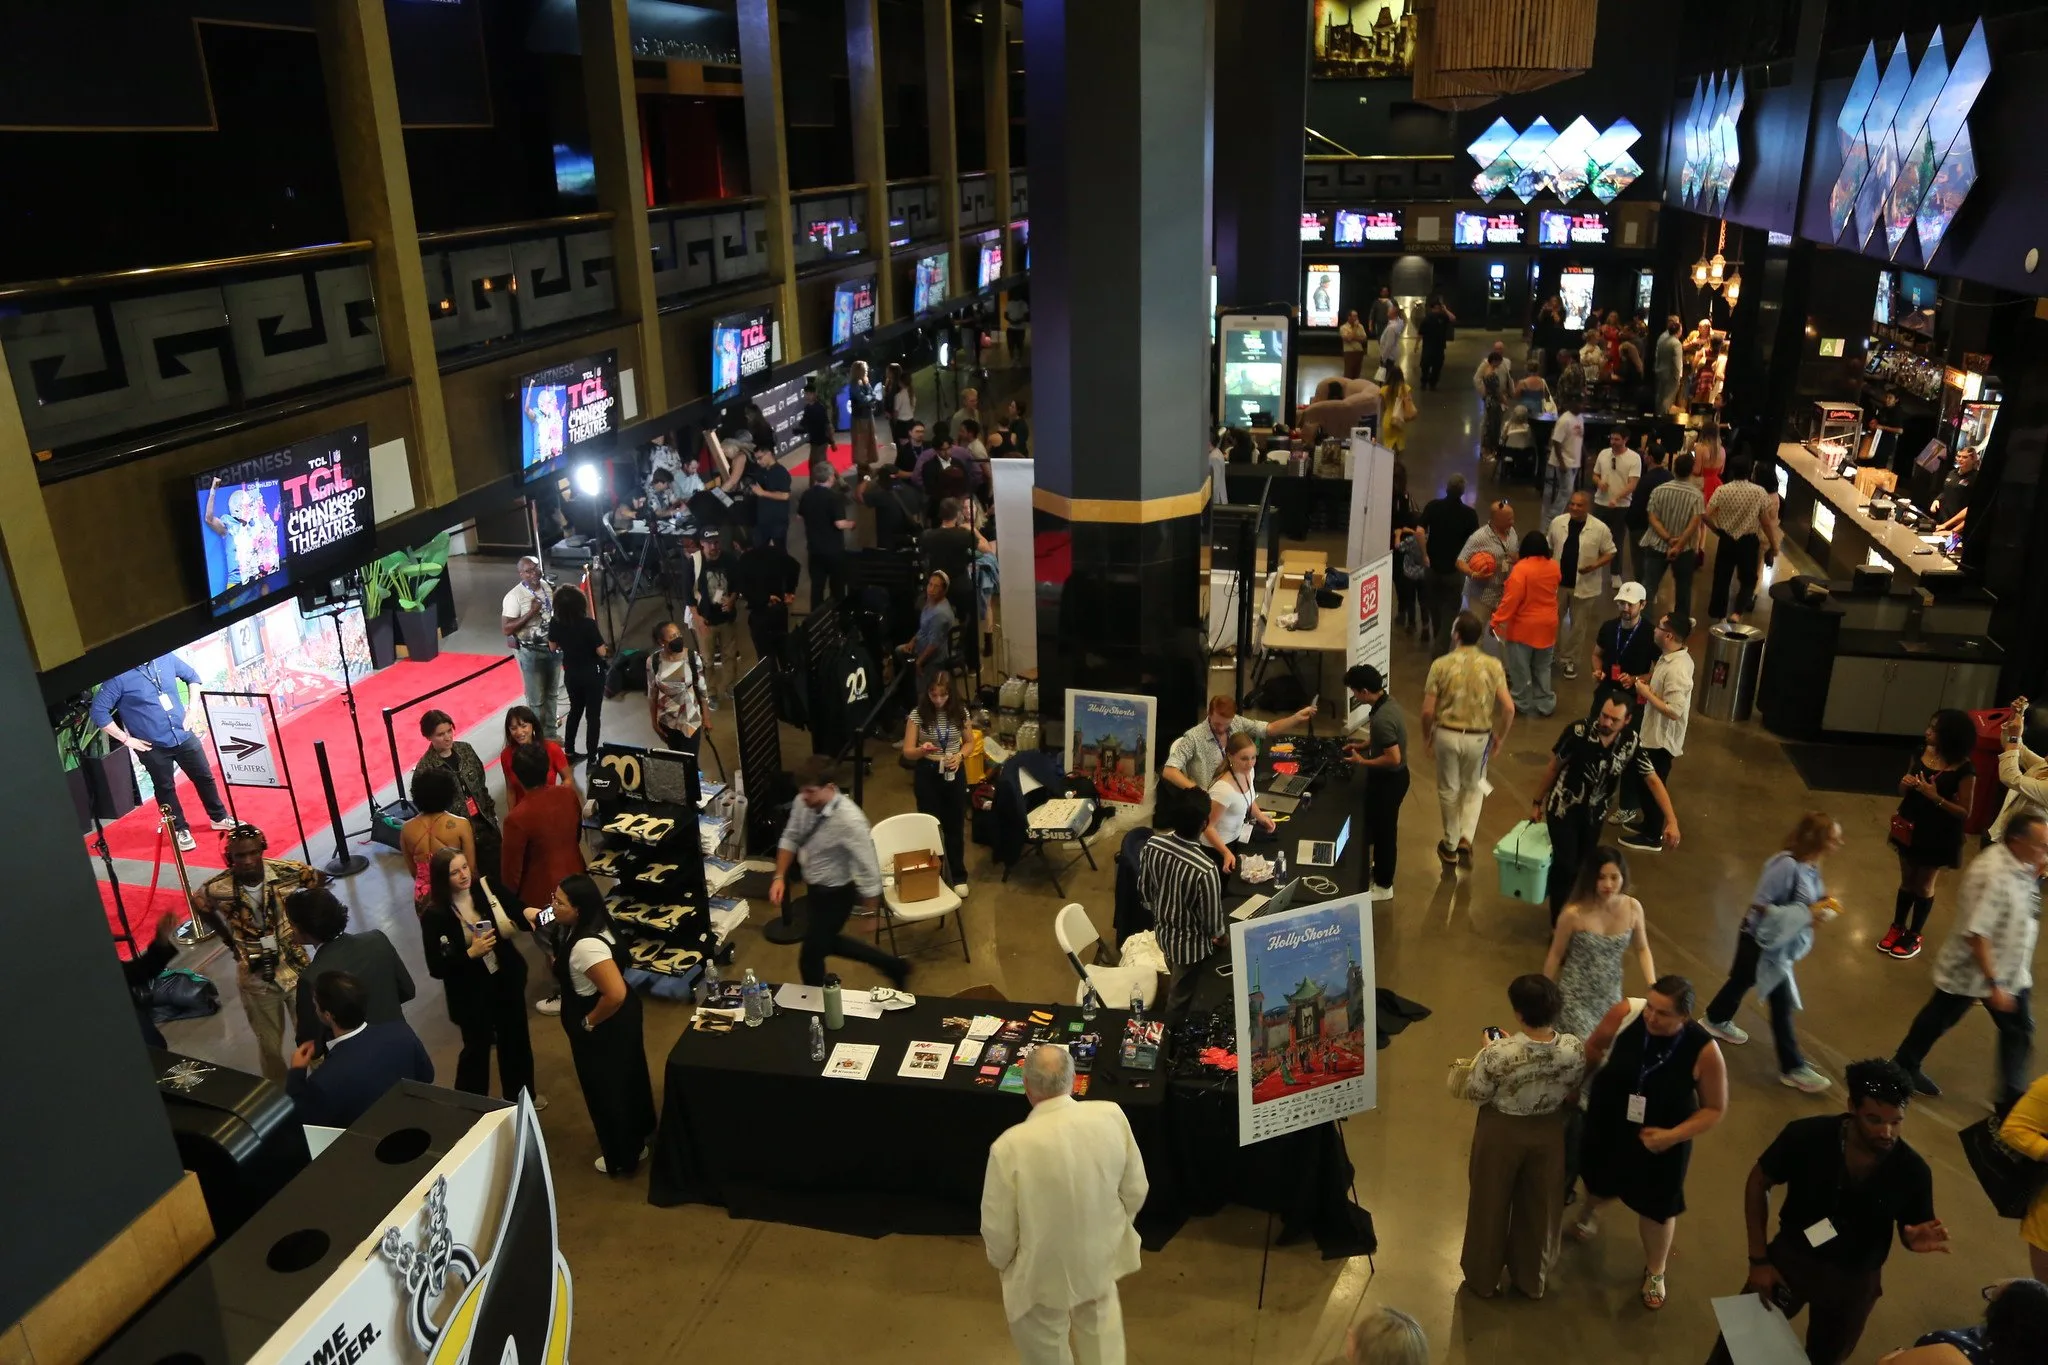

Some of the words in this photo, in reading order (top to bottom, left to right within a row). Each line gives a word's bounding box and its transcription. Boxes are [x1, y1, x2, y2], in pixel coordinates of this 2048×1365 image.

[741, 325, 767, 348] TCL
[1822, 342, 1832, 352] A
[568, 378, 607, 409] TCL
[569, 416, 607, 442] THEATRES
[308, 456, 327, 469] TCL
[283, 463, 352, 508] TCL
[289, 513, 356, 553] THEATRES
[1362, 580, 1376, 594] STAGE
[1363, 590, 1376, 614] 32
[846, 667, 867, 704] 20
[1087, 703, 1136, 716] HollyShorts
[230, 763, 266, 773] THEATERS
[1267, 924, 1341, 951] HollyShorts
